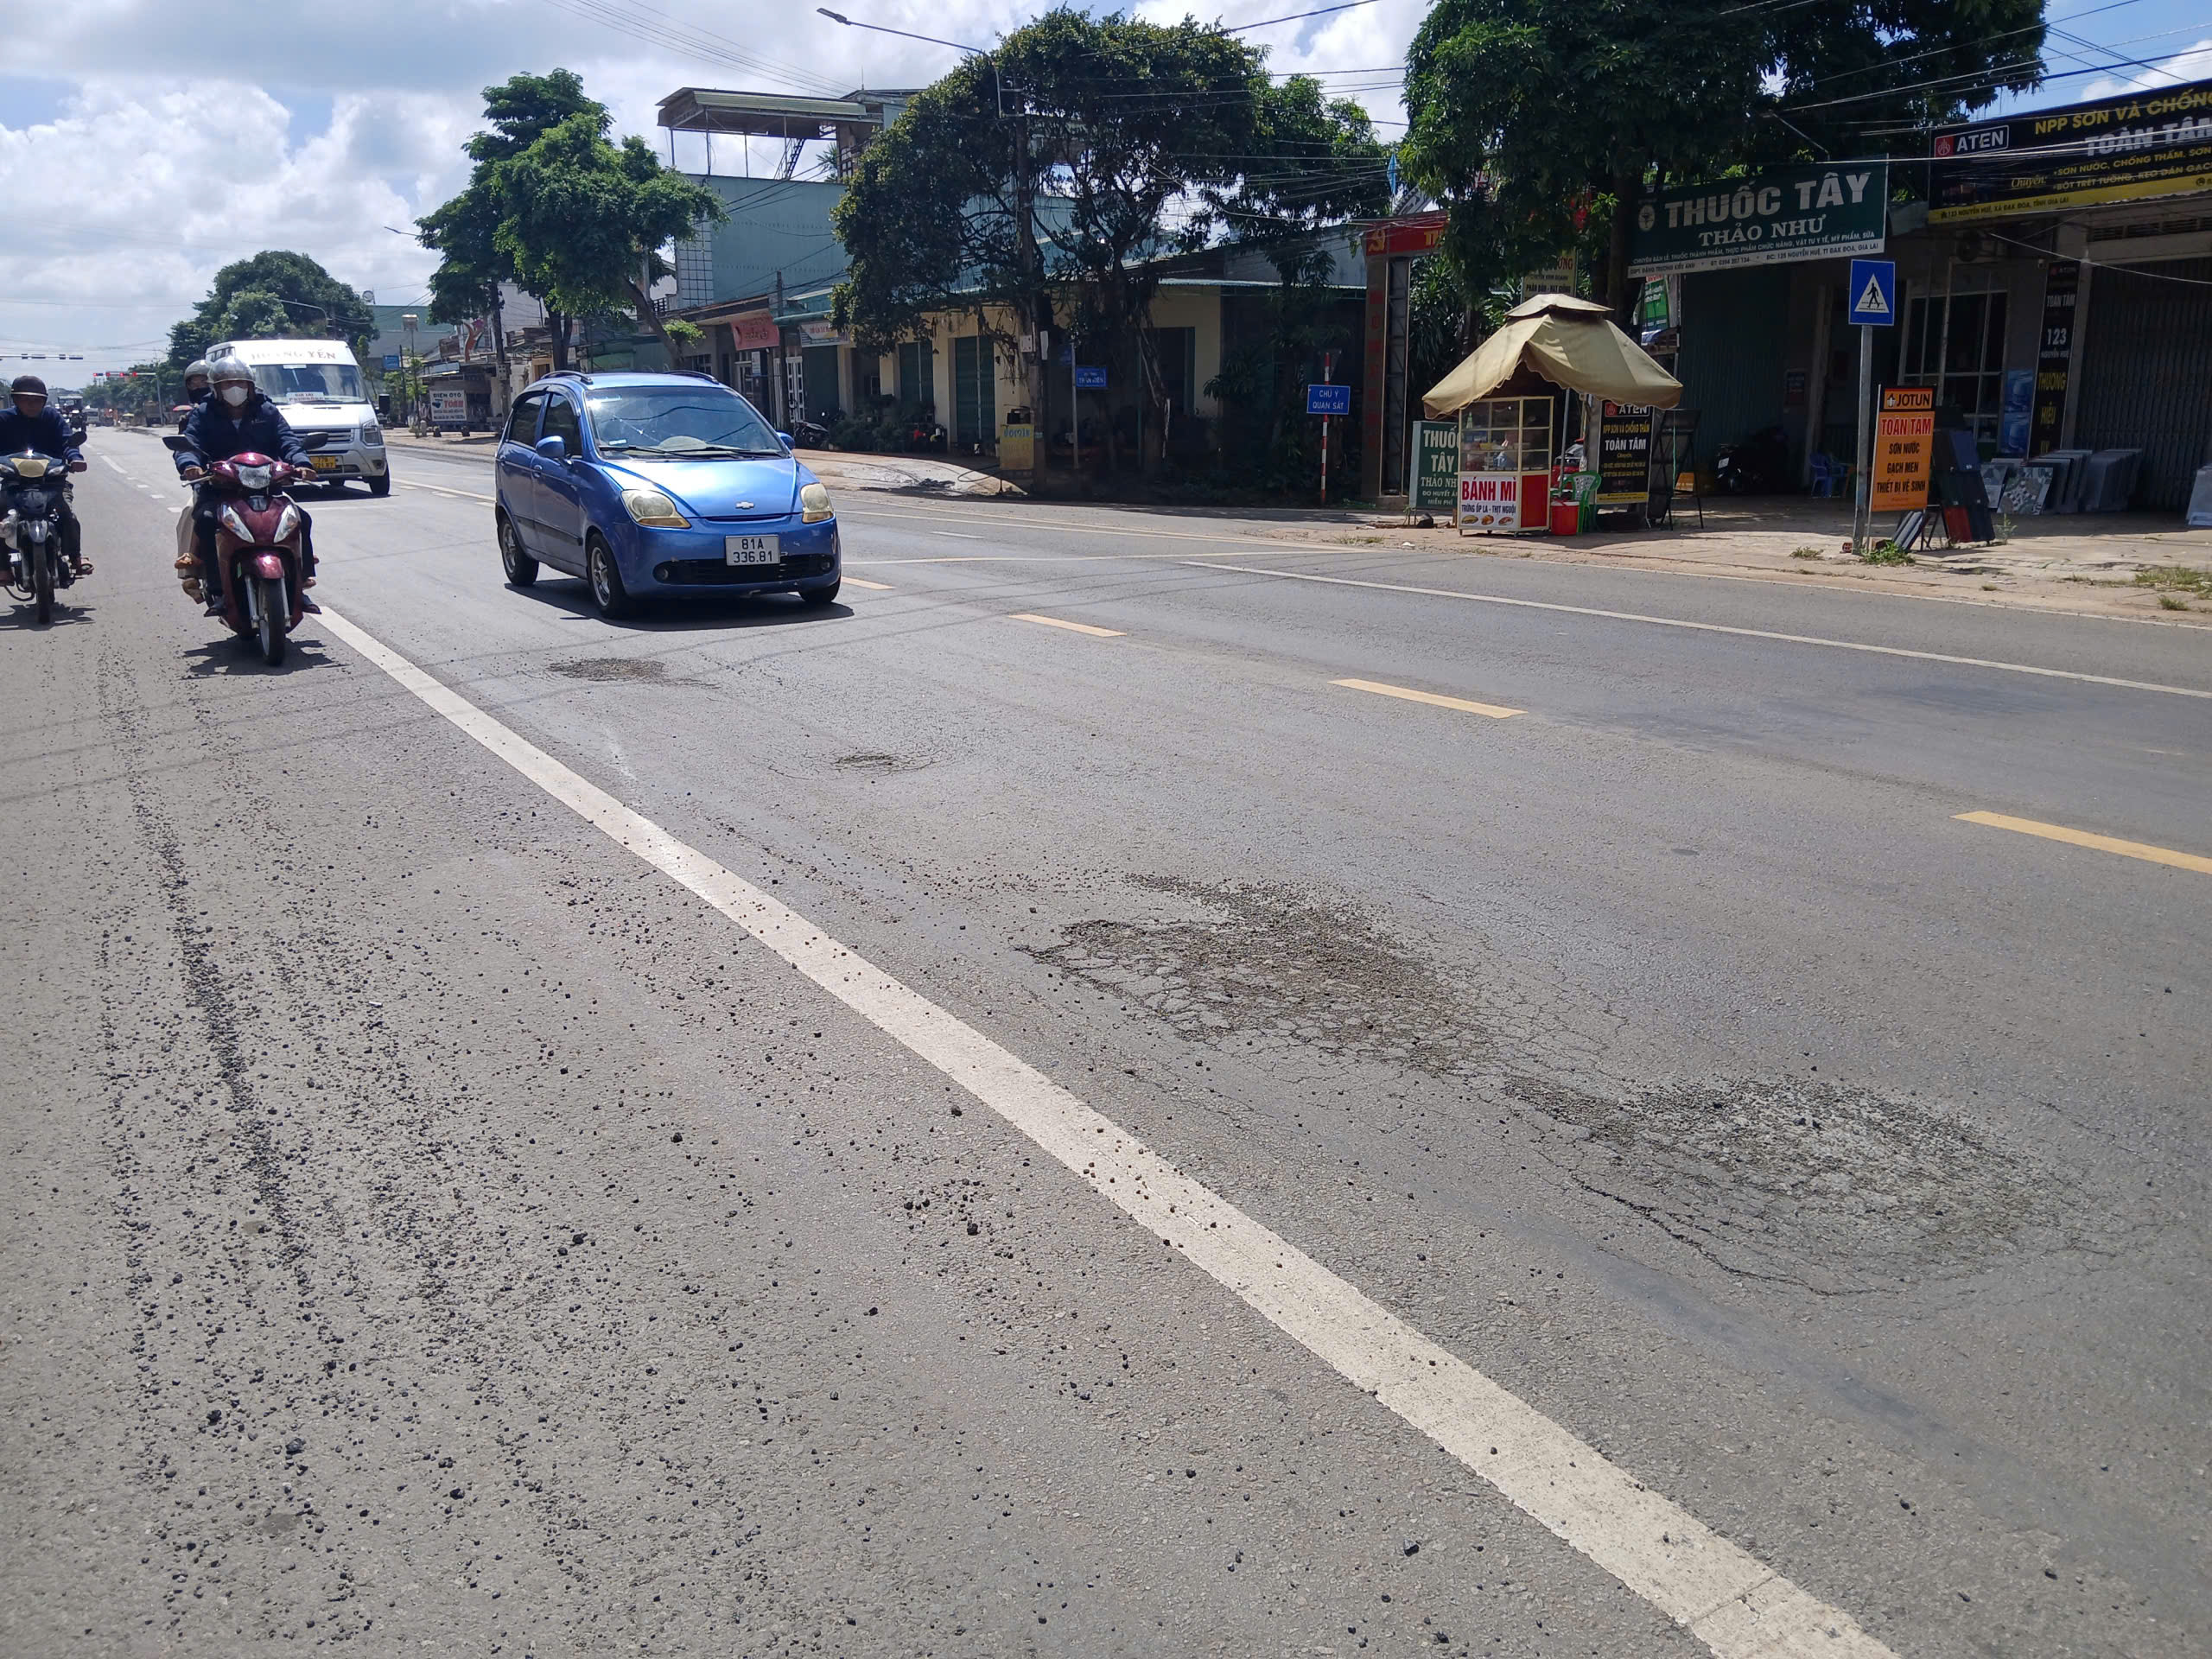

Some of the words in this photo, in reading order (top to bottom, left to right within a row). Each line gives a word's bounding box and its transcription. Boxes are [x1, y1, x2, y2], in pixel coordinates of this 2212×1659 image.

[2035, 118, 2068, 135] NPP
[2072, 110, 2109, 129] SƠN
[2115, 100, 2141, 121] VÀ
[1956, 130, 2004, 152] ATEN
[2085, 126, 2153, 156] TOÀN
[1664, 180, 1781, 228] THUỐC
[1795, 171, 1872, 210] TÂY
[1699, 222, 1763, 246] THẢO
[1770, 213, 1827, 238] NHƯ
[2047, 327, 2067, 345] 123
[1313, 401, 1331, 410] QUAN
[1897, 393, 1930, 407] JOTUN
[1882, 415, 1908, 435] TOÀN
[1910, 415, 1931, 435] TÂM
[1605, 437, 1627, 451] TOÀN
[1629, 436, 1647, 450] TÂM
[1431, 452, 1454, 473] TÂY
[1421, 474, 1443, 487] THẢO
[1445, 477, 1459, 488] NH
[1462, 476, 1497, 501] BÁNH
[1500, 476, 1516, 502] MÌ
[1483, 505, 1488, 513] LA
[741, 537, 765, 550] 81A
[733, 550, 772, 563] 336.81
